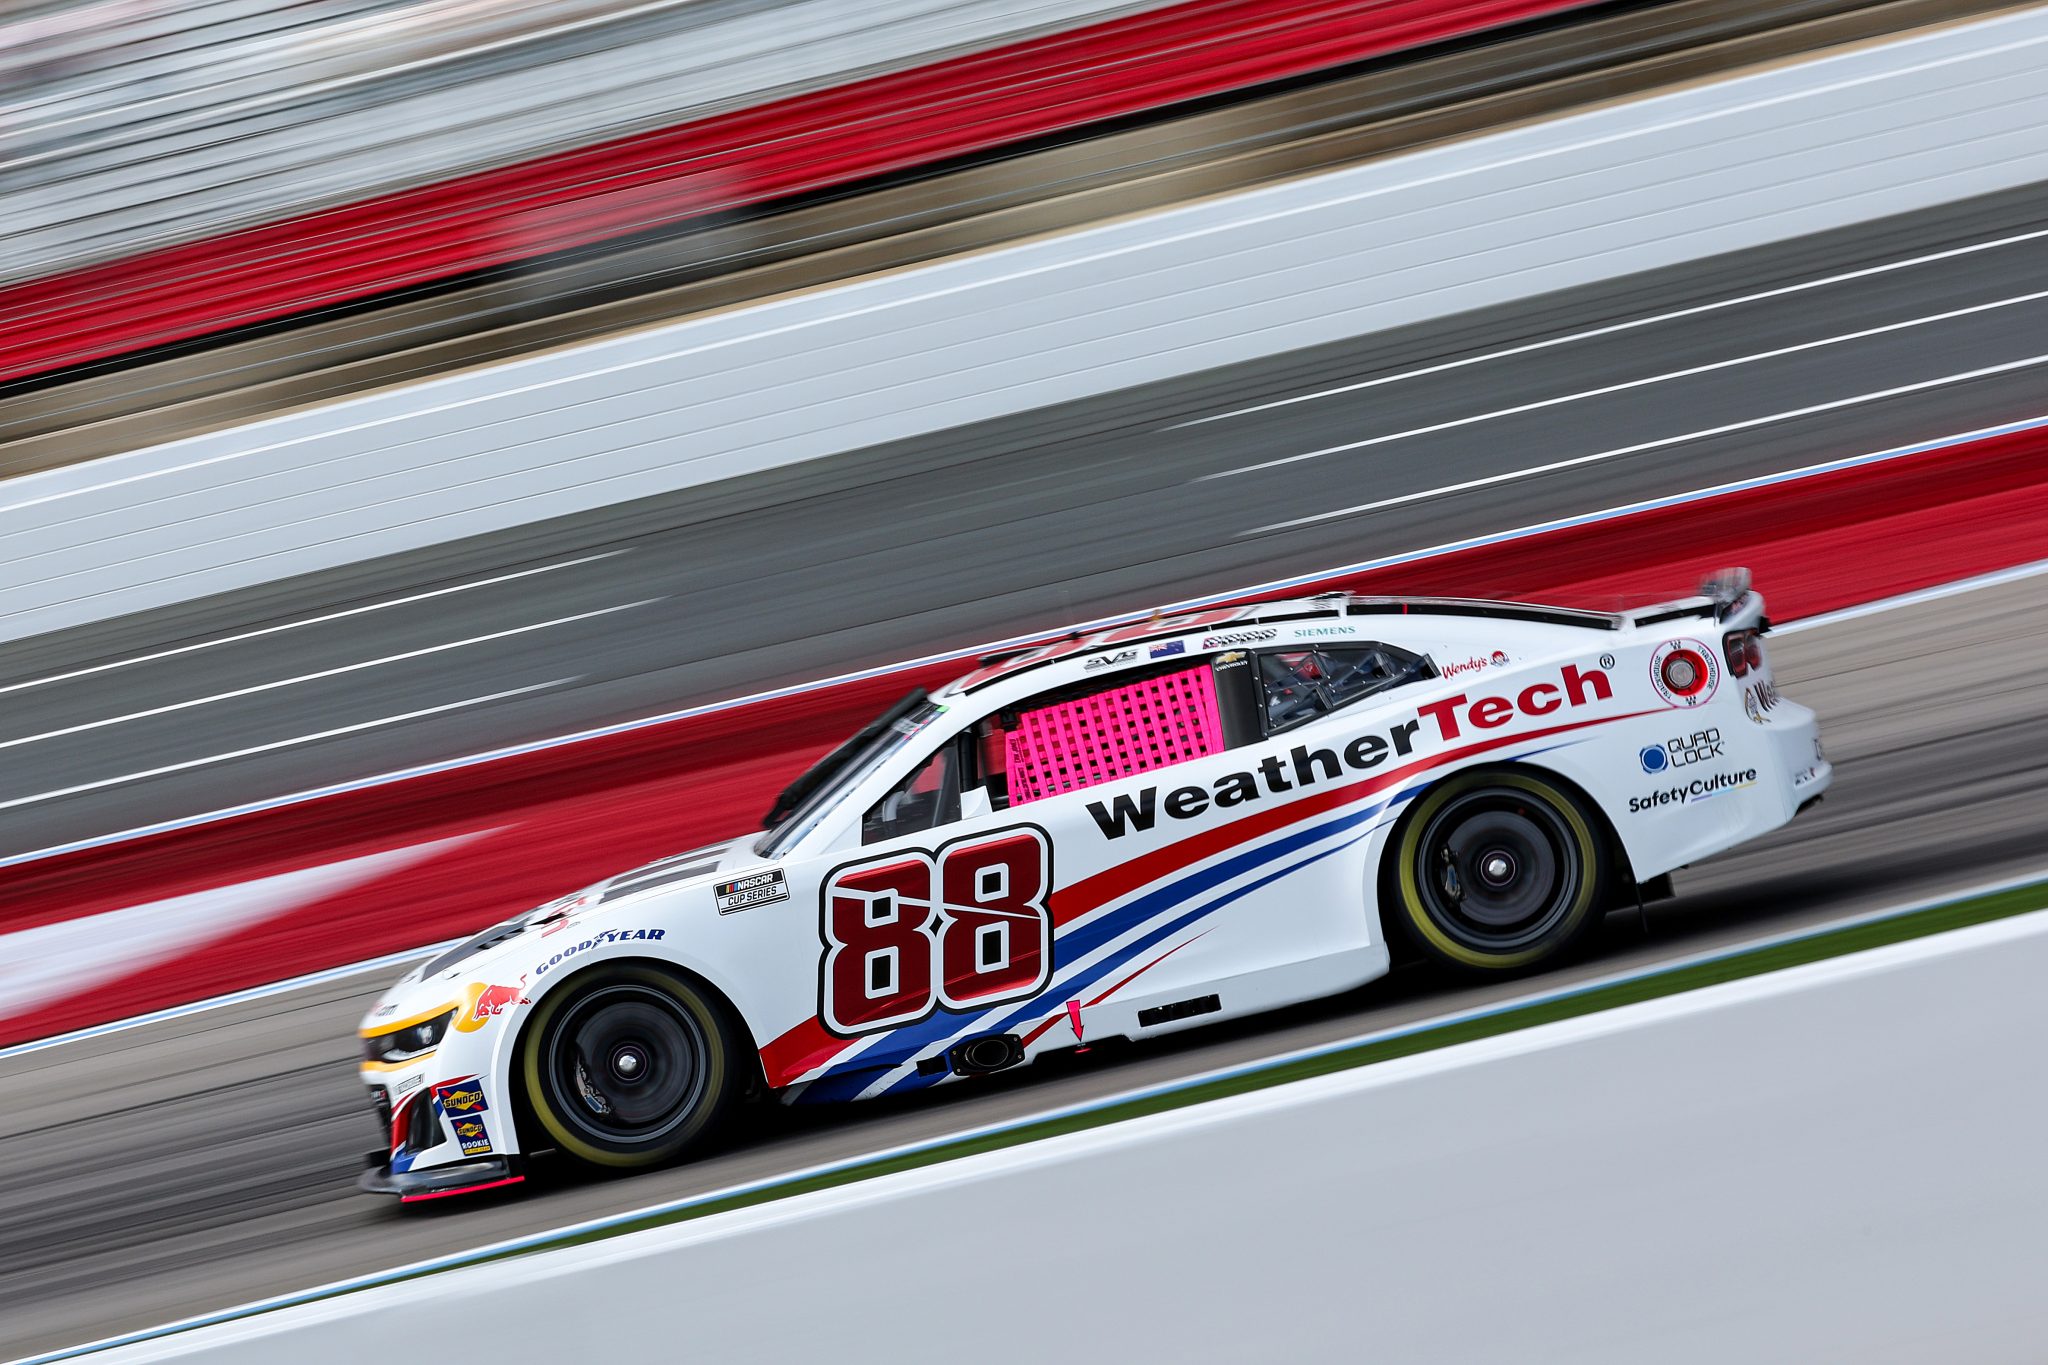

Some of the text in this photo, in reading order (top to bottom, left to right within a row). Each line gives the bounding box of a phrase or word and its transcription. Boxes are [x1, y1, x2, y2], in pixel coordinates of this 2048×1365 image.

[1294, 626, 1356, 638] SIEMENS
[1441, 657, 1488, 680] Wendy's
[1667, 727, 1720, 753] QUAD
[1671, 741, 1724, 768] LOCK
[1629, 768, 1757, 813] SafetyCulture
[738, 874, 773, 890] NASCAR
[728, 886, 777, 905] CUP SERIES
[817, 821, 1054, 1041] 88
[536, 928, 666, 975] GOODYEAR
[445, 1091, 481, 1108] SUNOCO
[458, 1124, 482, 1135] SUNOCO
[461, 1139, 489, 1149] ROOKIE
